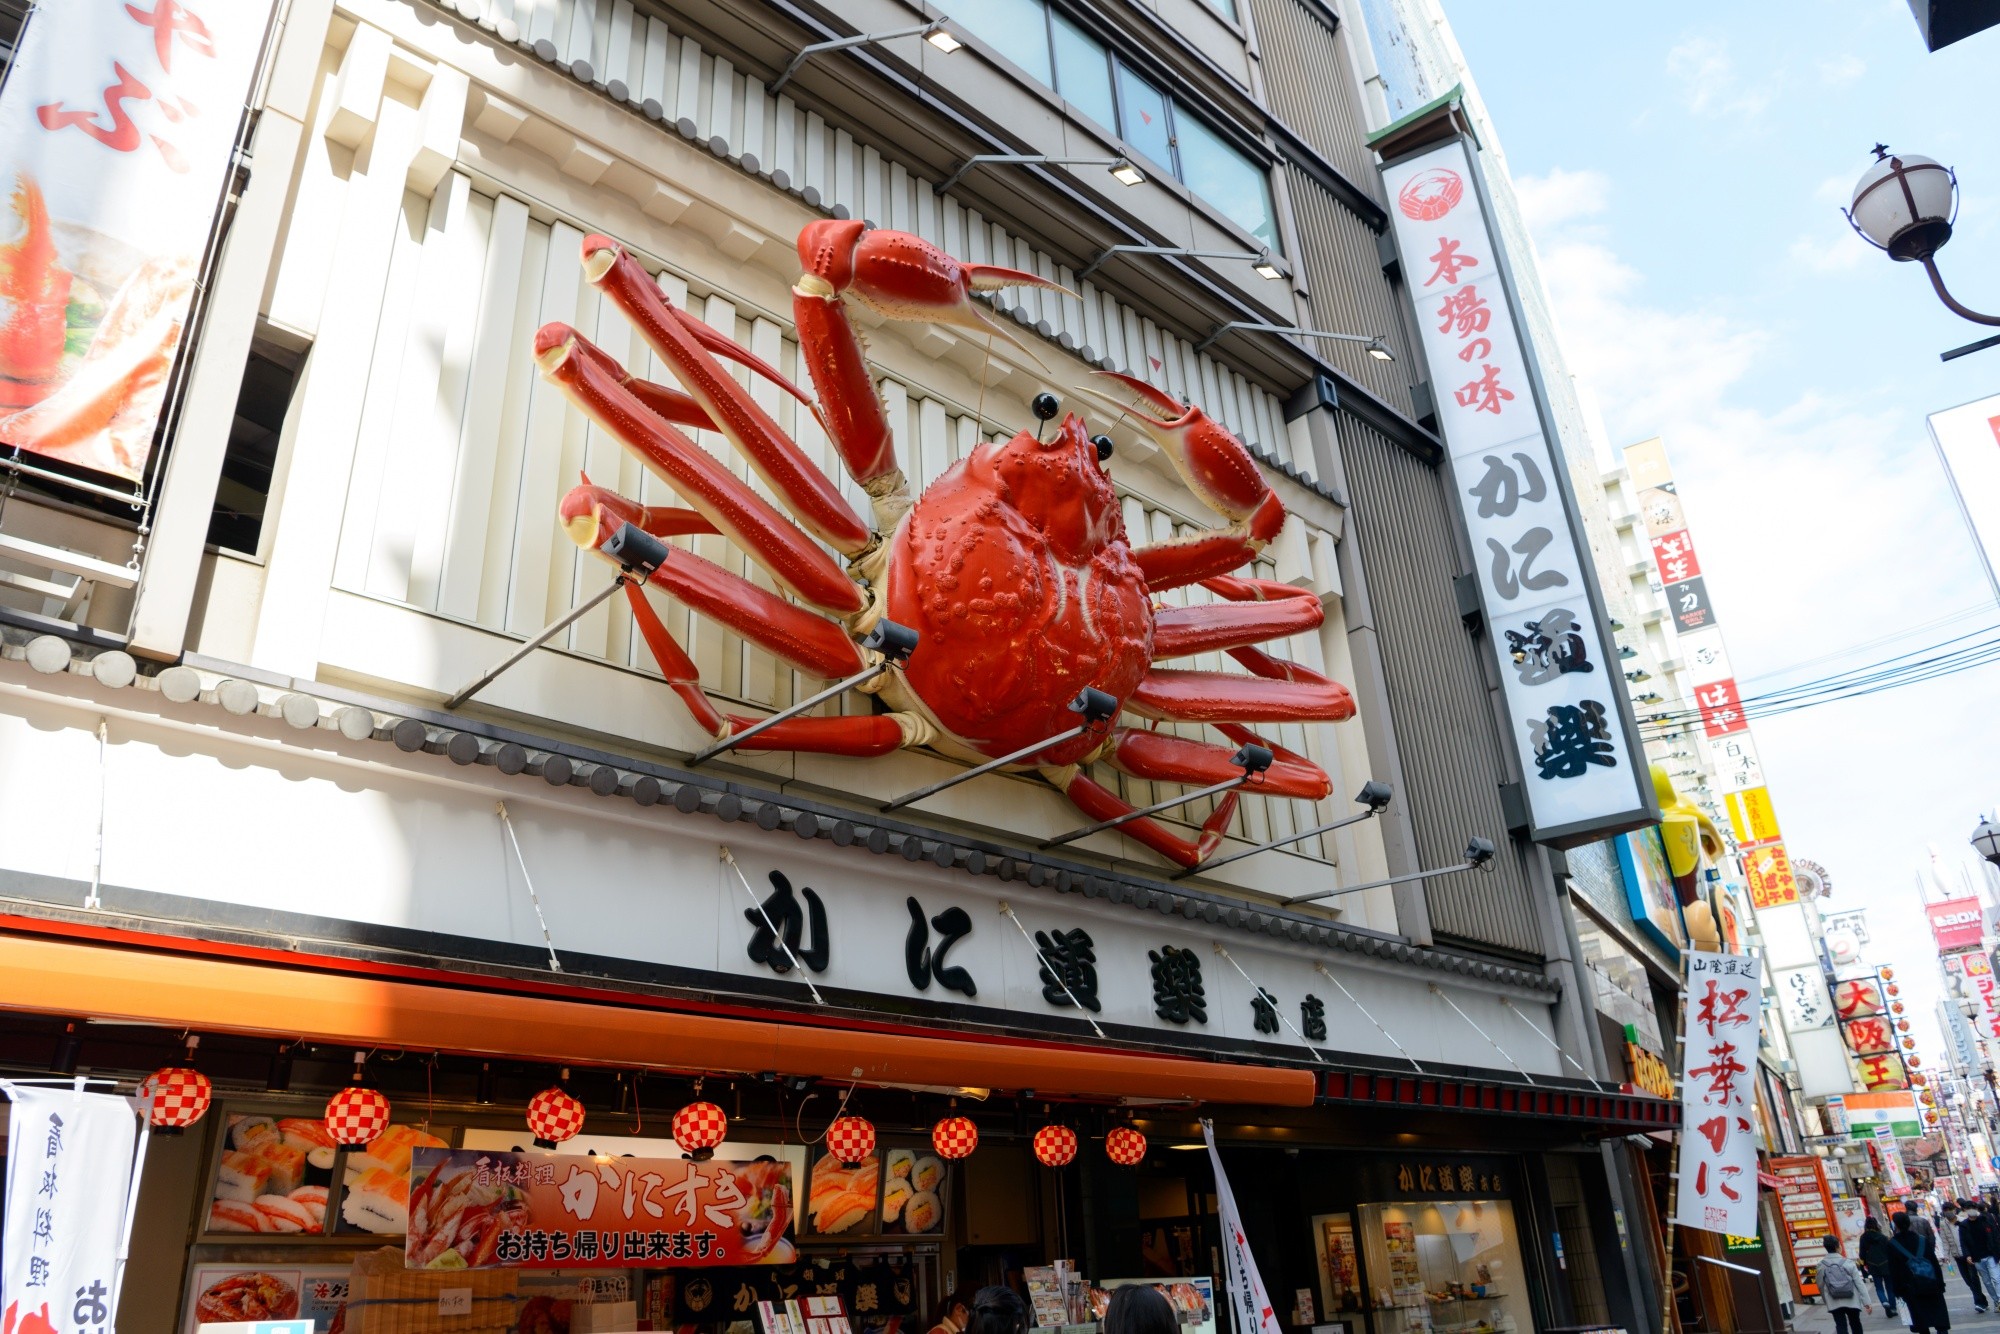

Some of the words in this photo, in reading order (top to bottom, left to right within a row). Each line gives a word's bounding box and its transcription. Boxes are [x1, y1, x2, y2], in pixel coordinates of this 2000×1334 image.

[1423, 236, 1515, 415] 本場の味
[1468, 452, 1617, 780] かに道楽
[1726, 741, 1756, 786] 白木屋
[1693, 958, 1758, 980] 山陰直送
[1688, 980, 1751, 1201] 松葉かに
[471, 1155, 556, 1188] 看板料理
[559, 1162, 748, 1229] かにすき
[496, 1230, 726, 1261] お持ち帰り出来ます。
